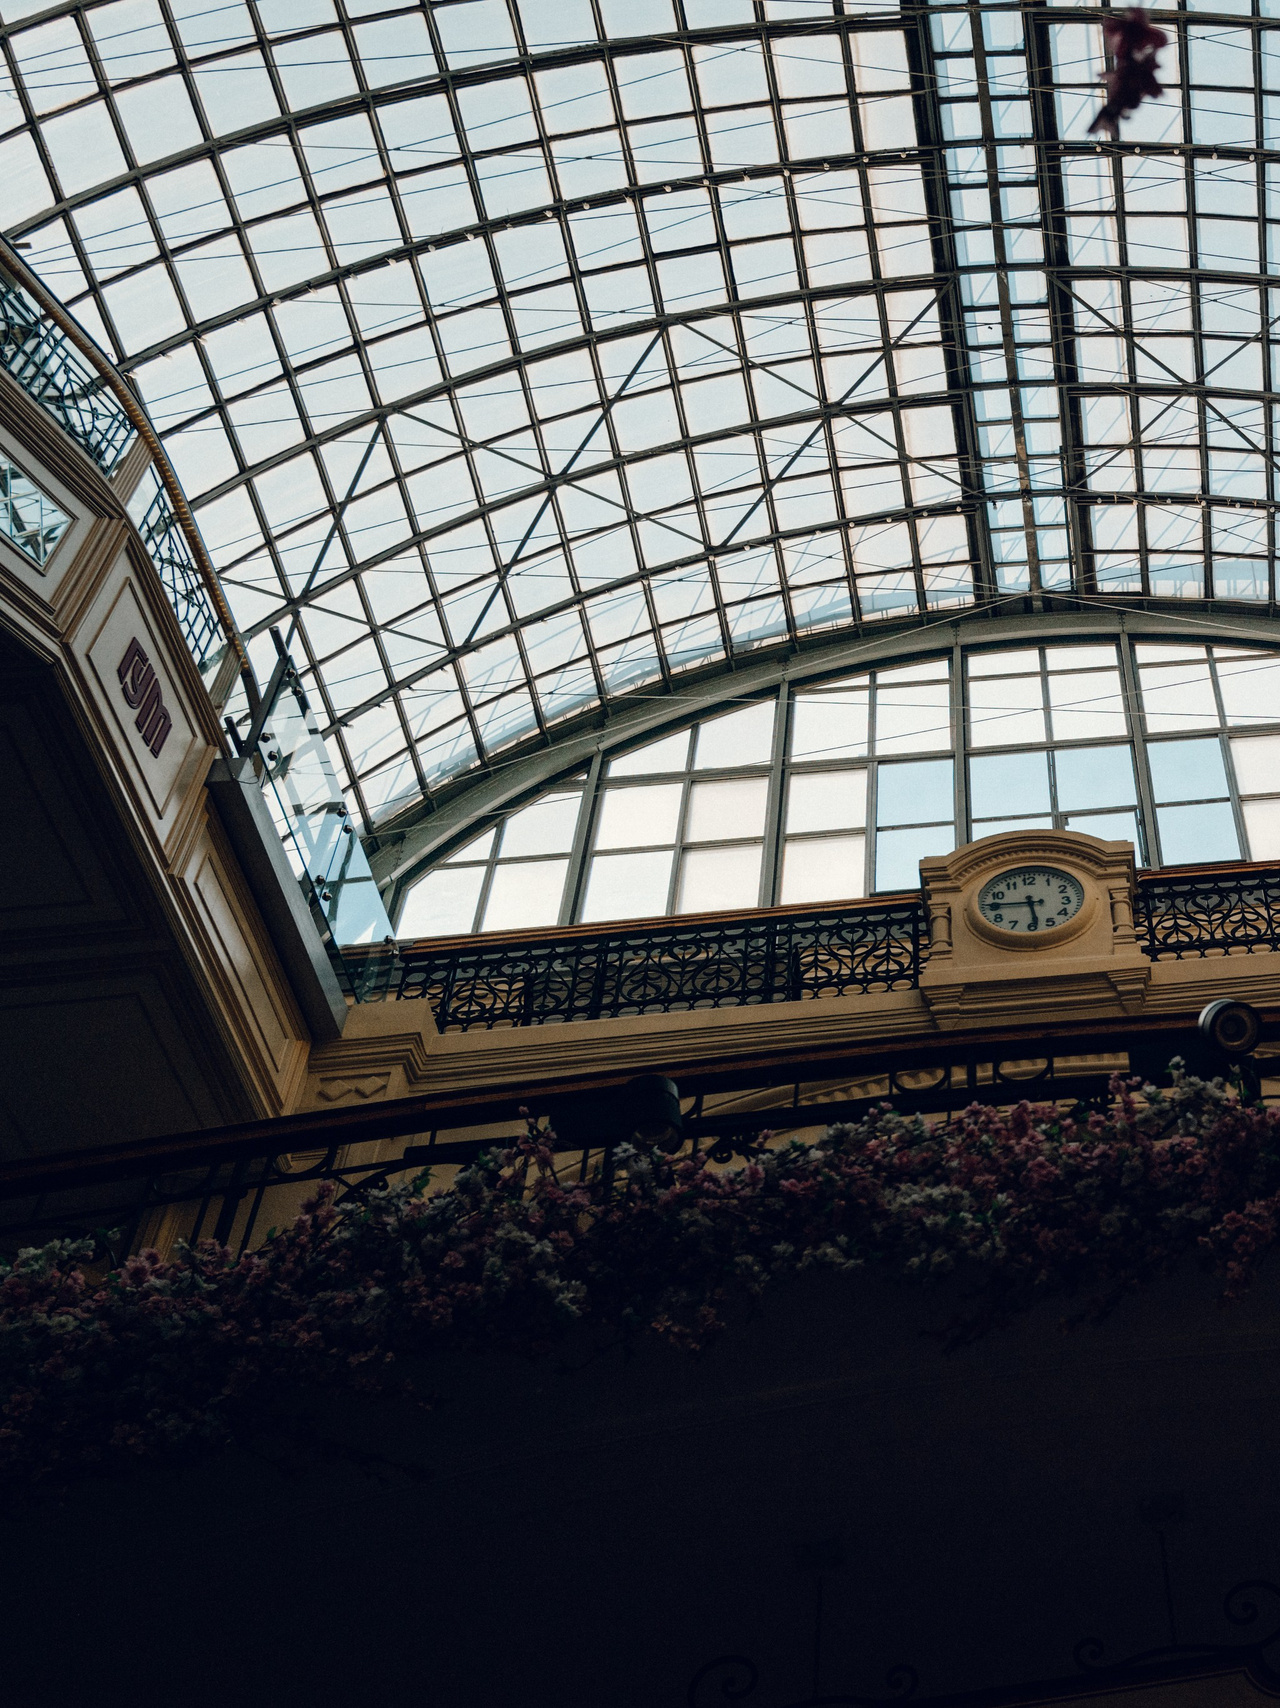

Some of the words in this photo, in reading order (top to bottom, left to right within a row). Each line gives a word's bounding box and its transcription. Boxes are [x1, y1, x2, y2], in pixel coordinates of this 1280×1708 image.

[1006, 881, 1017, 890] 11
[1022, 876, 1036, 886] 12
[1046, 878, 1051, 886] 1
[1058, 884, 1067, 894] 2
[991, 891, 1004, 900] 10
[1061, 896, 1071, 905] 3
[1056, 907, 1069, 916] 4
[993, 913, 1003, 923] 8
[1045, 917, 1056, 927] 5
[1008, 920, 1019, 930] 7
[1027, 922, 1038, 932] 6
